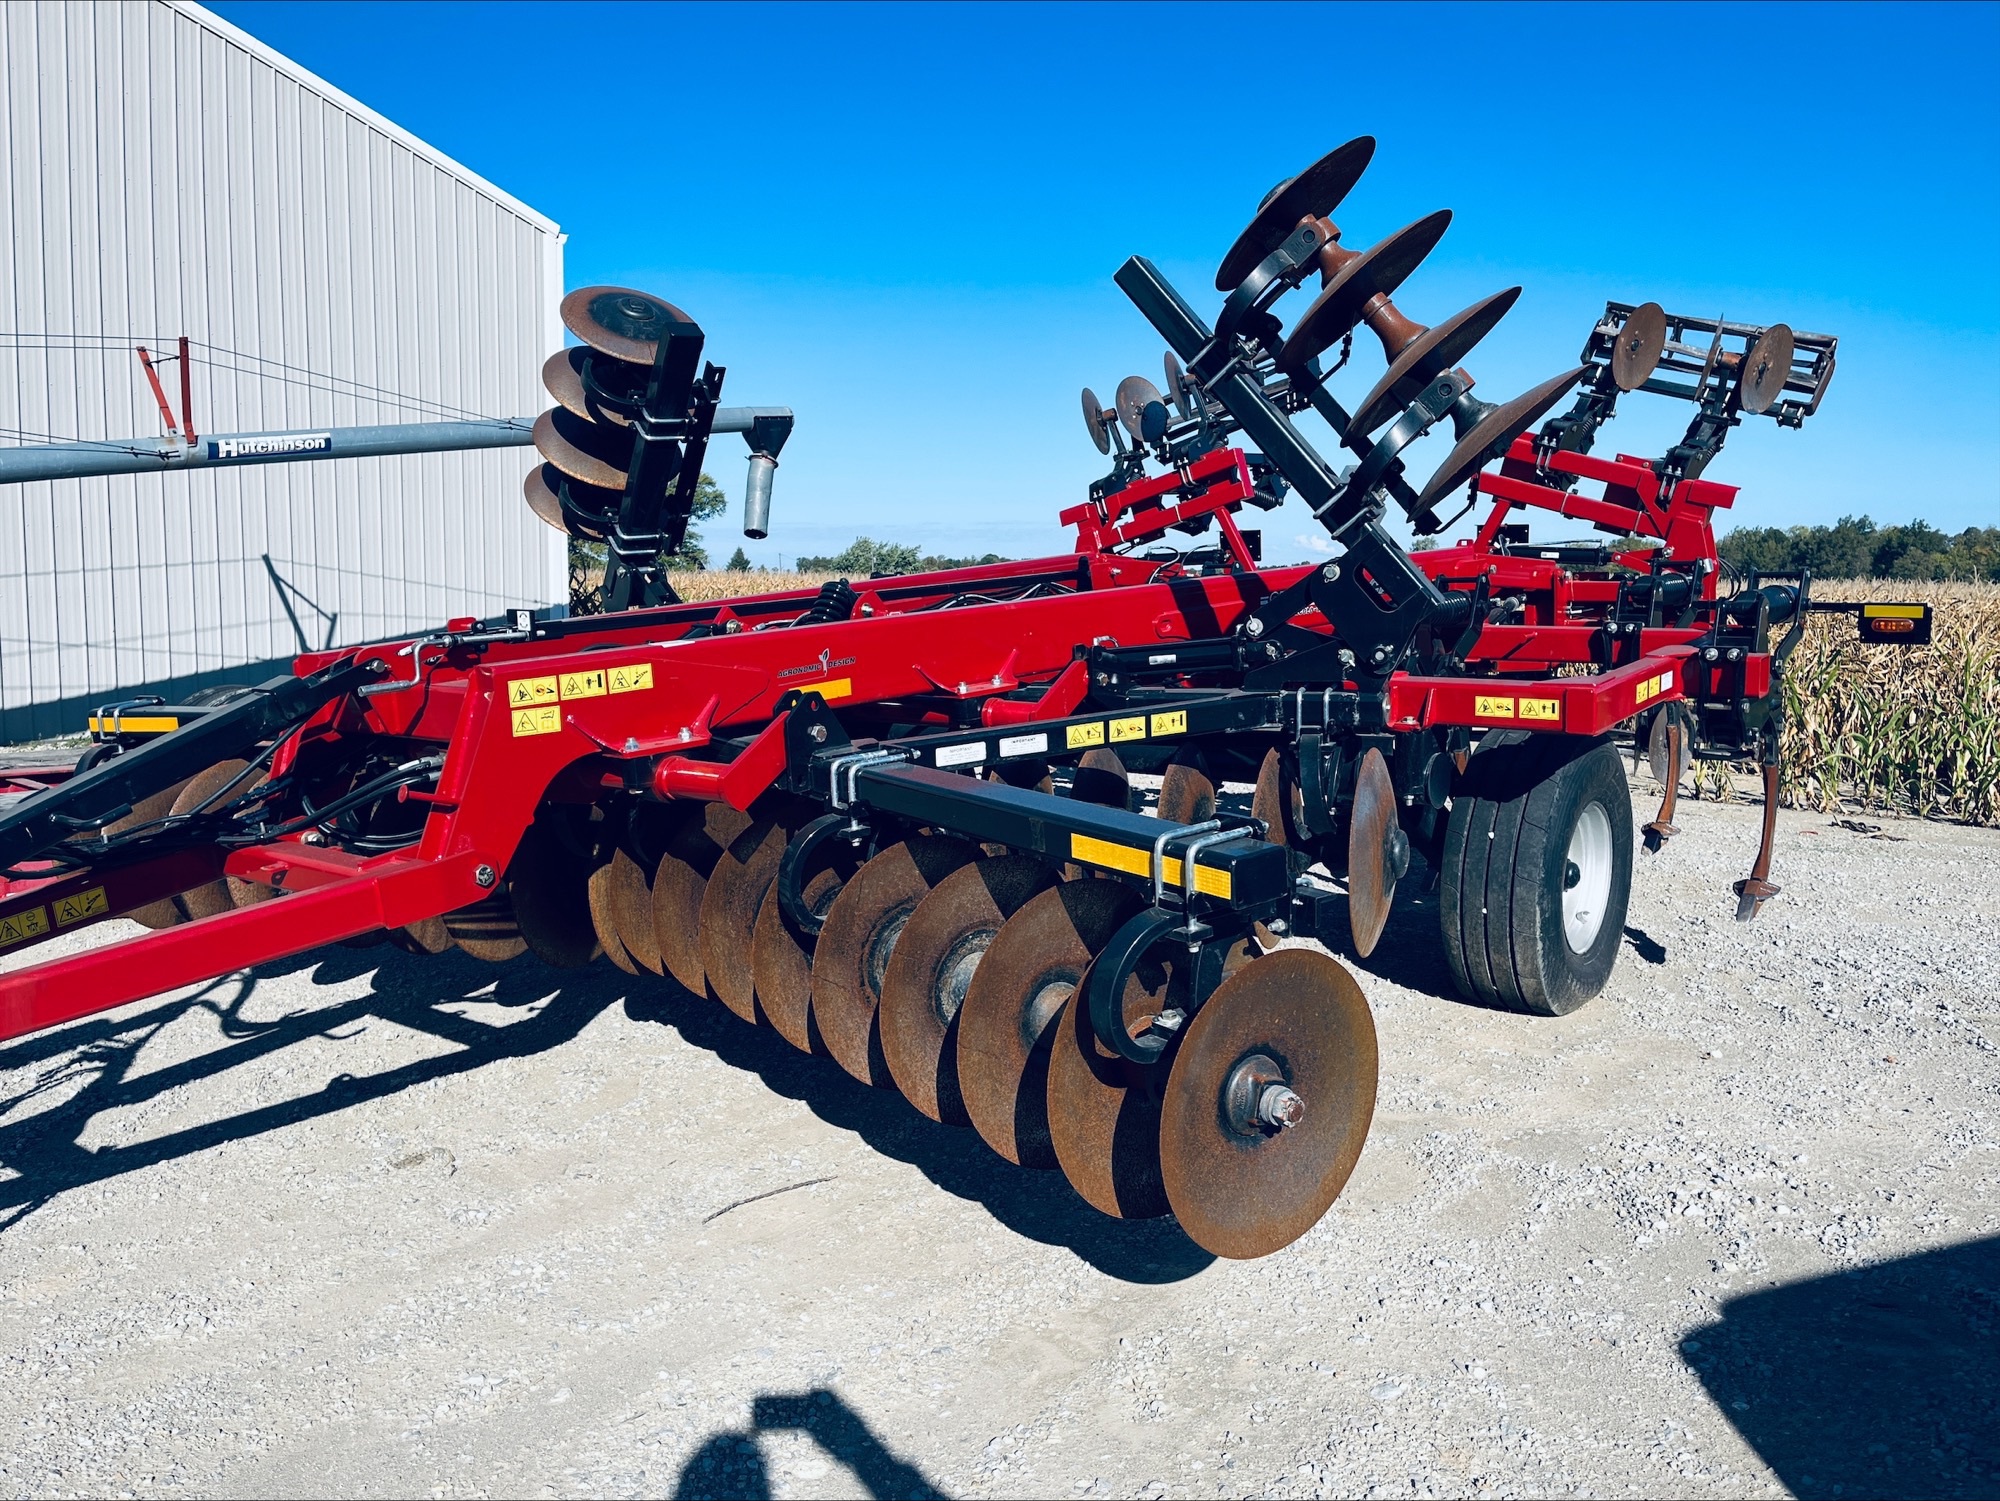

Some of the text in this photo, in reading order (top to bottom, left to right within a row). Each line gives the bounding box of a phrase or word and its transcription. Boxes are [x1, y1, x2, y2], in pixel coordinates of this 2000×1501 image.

[218, 438, 326, 458] Hutchinson
[777, 656, 856, 678] AGRONOMIC DESIGN
